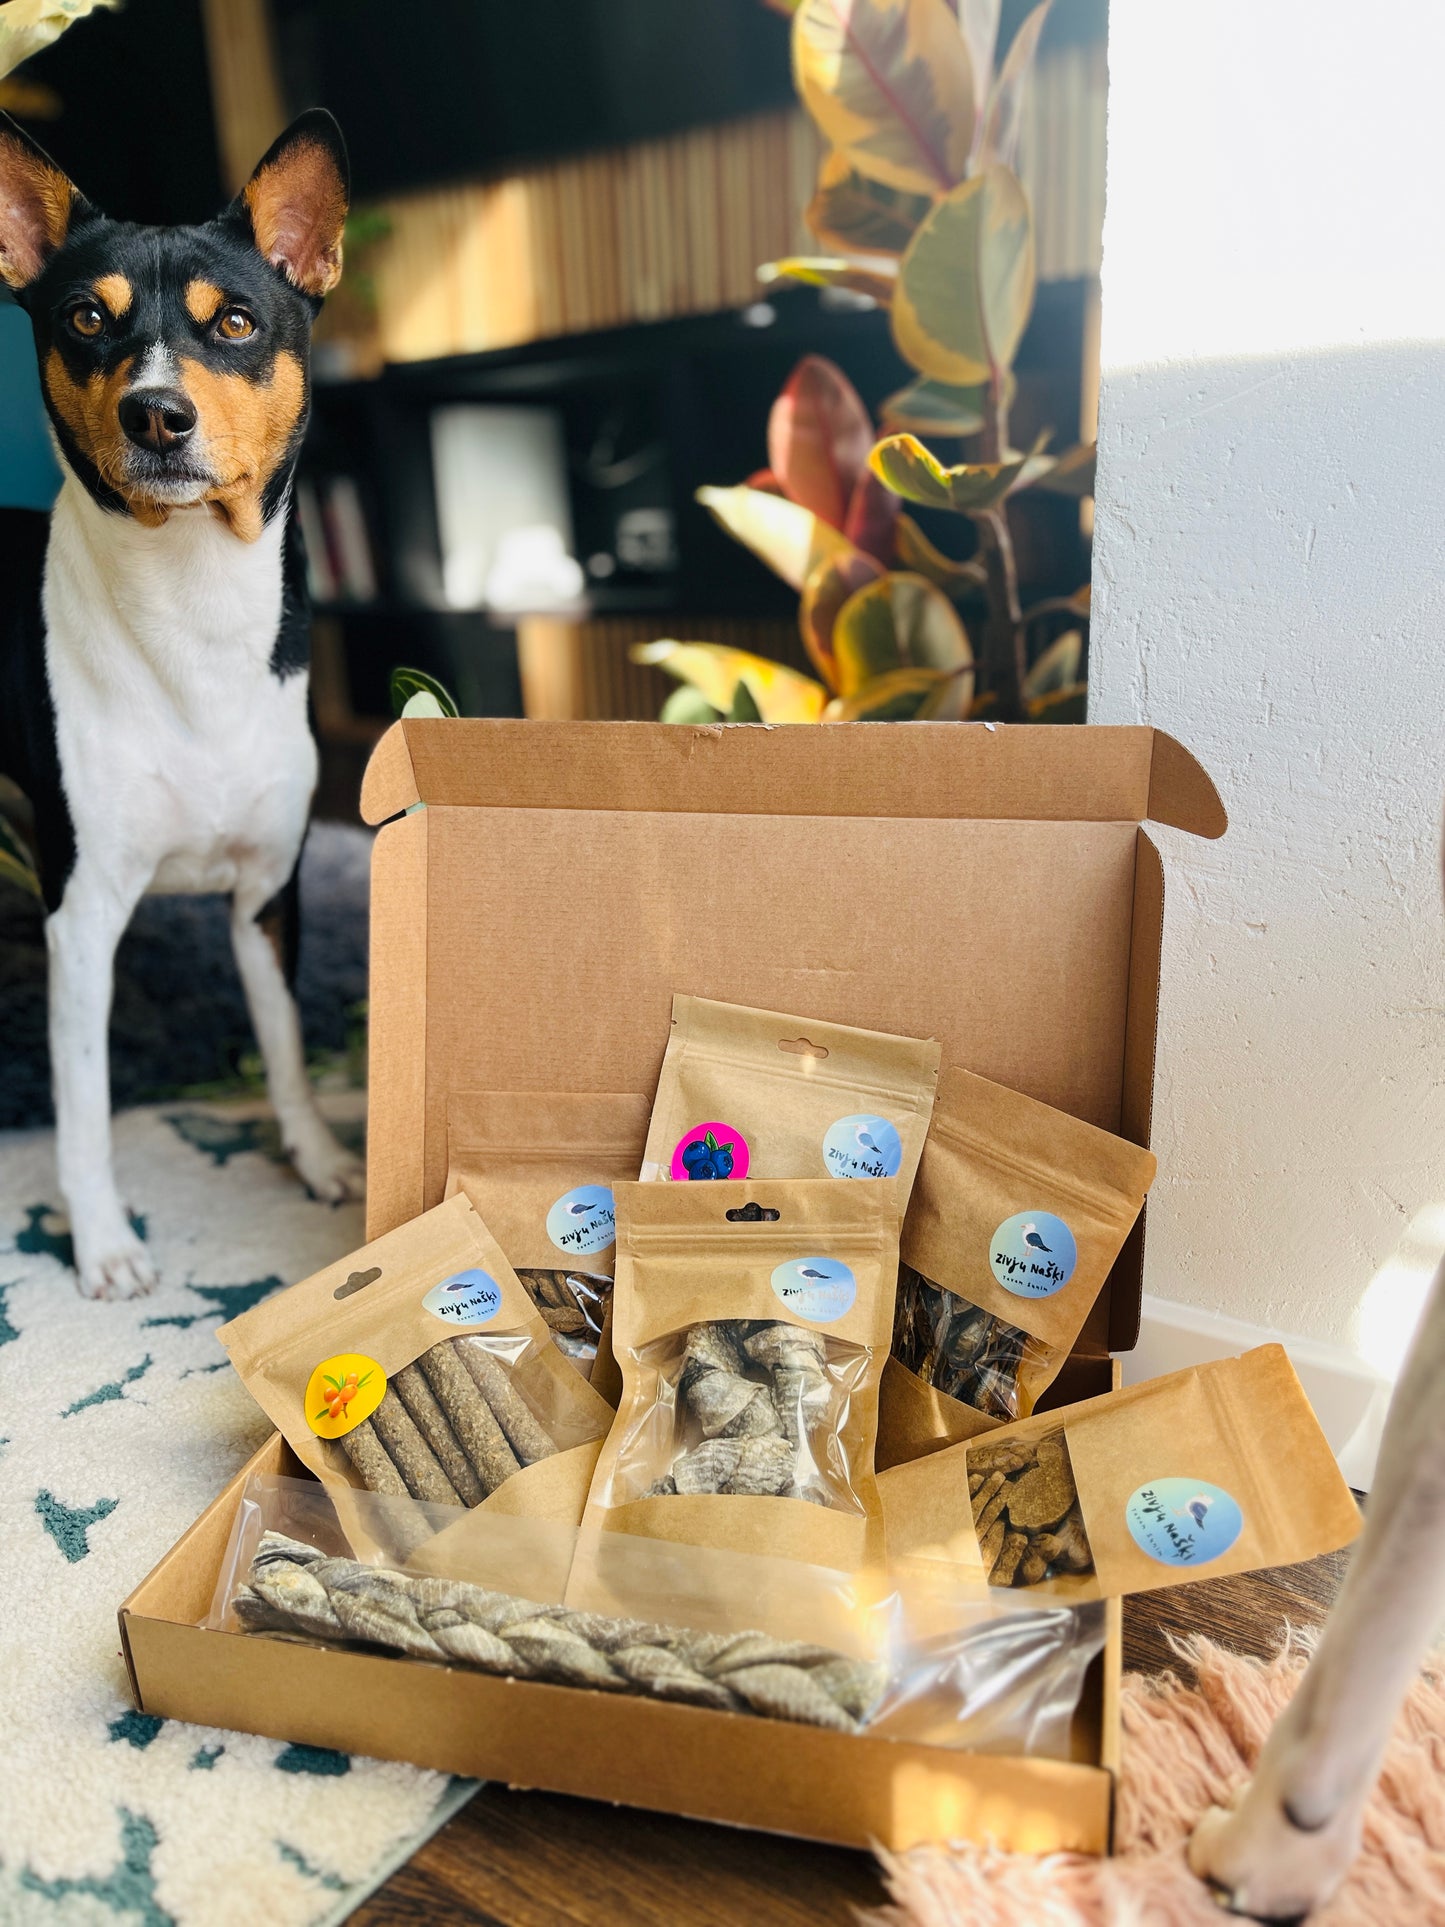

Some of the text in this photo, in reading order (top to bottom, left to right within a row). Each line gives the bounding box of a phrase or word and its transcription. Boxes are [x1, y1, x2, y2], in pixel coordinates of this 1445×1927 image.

[828, 1148, 857, 1169] Zivju
[560, 1228, 590, 1245] Zivju
[995, 1253, 1065, 1286] Zivju Našķi
[438, 1290, 498, 1316] Zivju Našķi
[1141, 1490, 1196, 1561] Zivju Našķi
